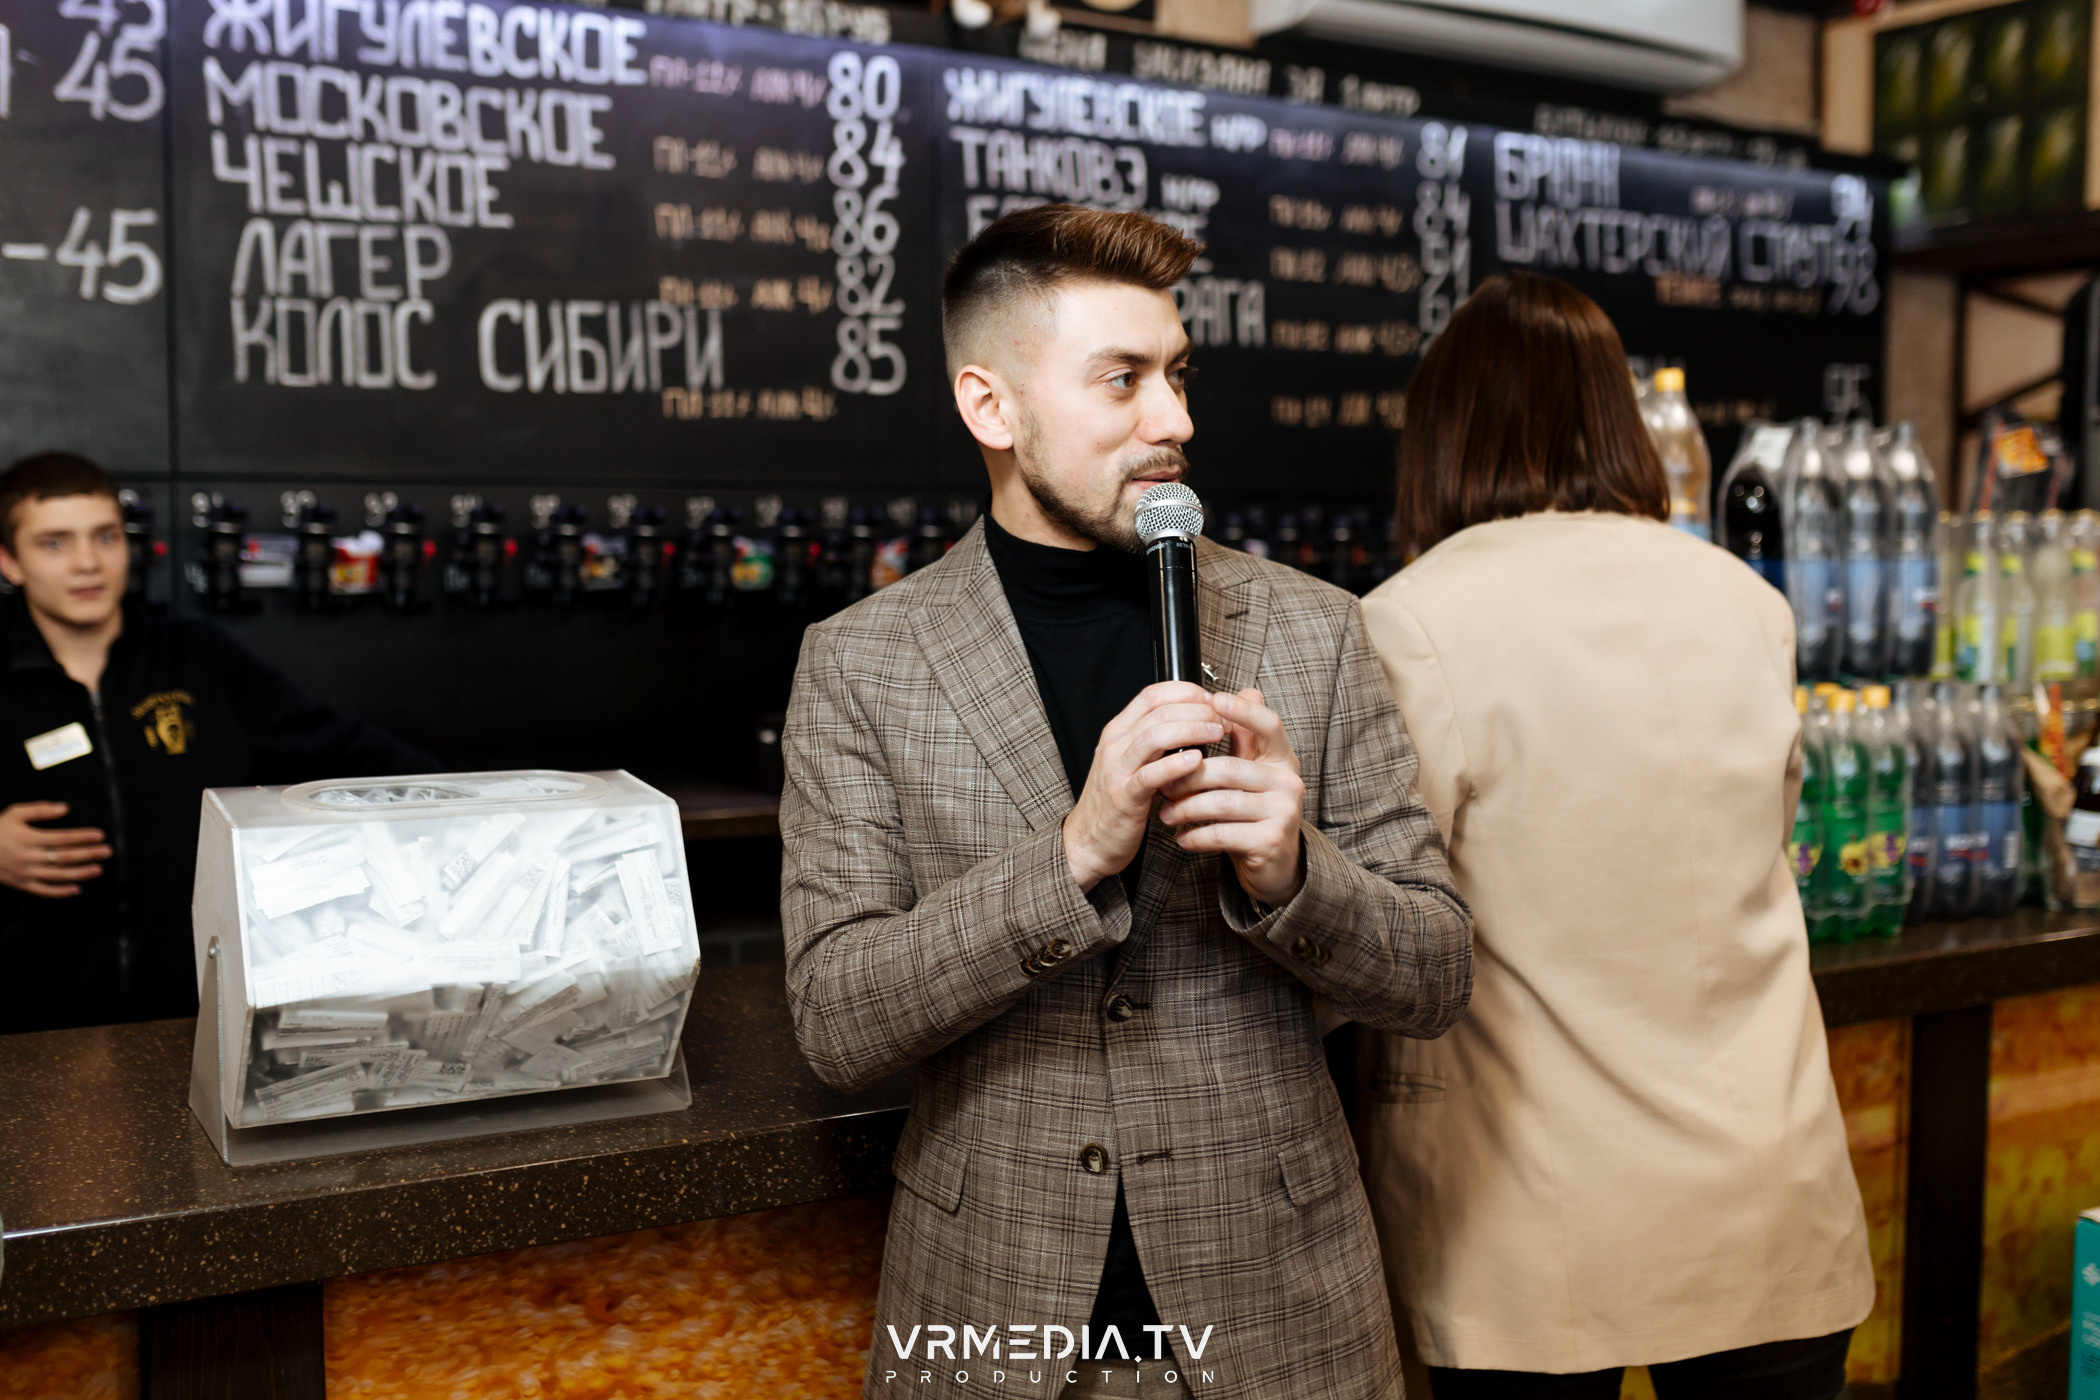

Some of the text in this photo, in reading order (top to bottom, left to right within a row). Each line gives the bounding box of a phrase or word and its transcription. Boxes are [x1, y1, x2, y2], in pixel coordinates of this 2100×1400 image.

[54, 31, 165, 122] 45
[203, 0, 648, 85] ЖИГУЛЕВСКОЕ
[827, 51, 901, 120] 80
[203, 56, 616, 170] МОСКОВСКОЕ
[828, 118, 906, 189] 84
[211, 130, 514, 229] ЧЕШСКОЕ
[832, 184, 900, 256] 86
[231, 217, 453, 302] ЛАГЕР
[835, 254, 906, 316] 82
[230, 298, 907, 396] КОЛОС СИБИРИ 85
